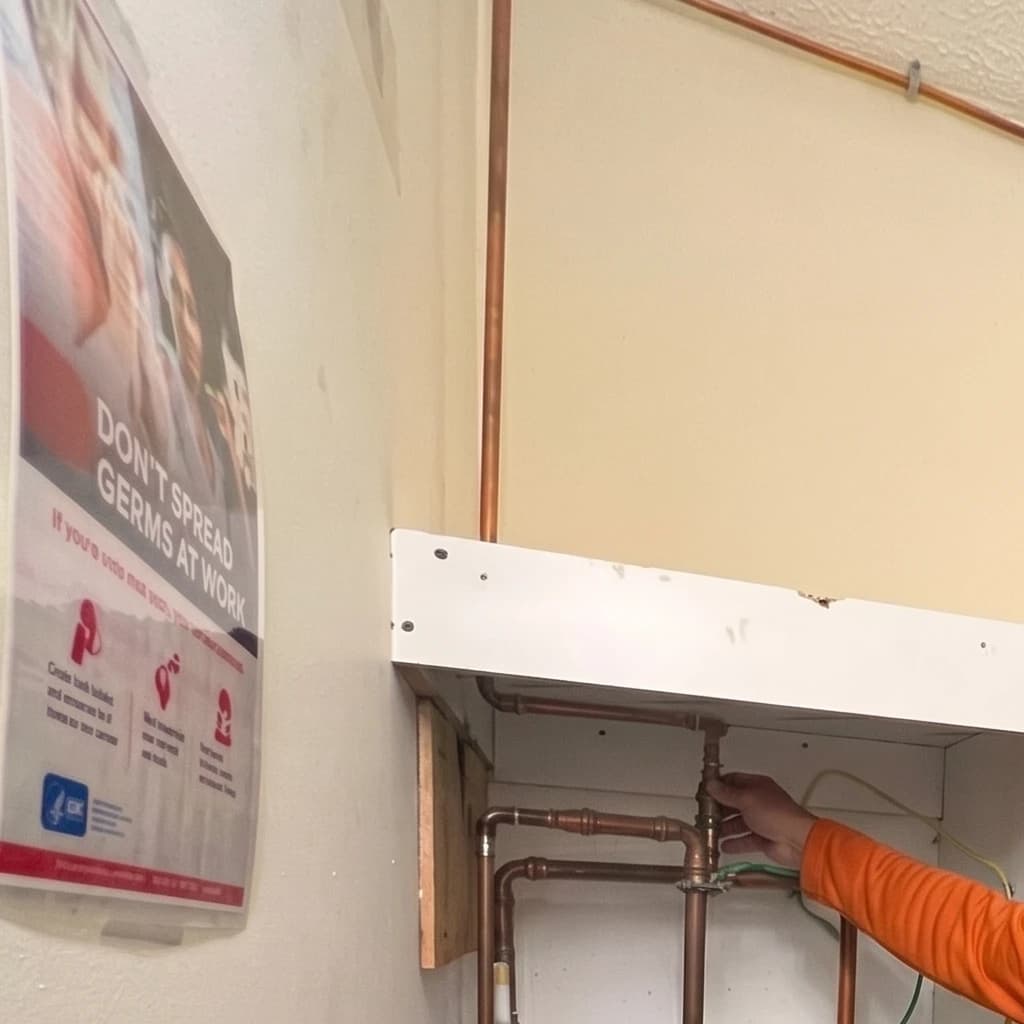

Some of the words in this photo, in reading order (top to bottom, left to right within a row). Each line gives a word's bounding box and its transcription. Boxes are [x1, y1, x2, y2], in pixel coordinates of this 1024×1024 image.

[97, 396, 169, 502] DON'T
[171, 482, 233, 570] SPREAD
[97, 458, 173, 559] GERMS
[175, 537, 199, 580] AT
[201, 557, 246, 628] WORK
